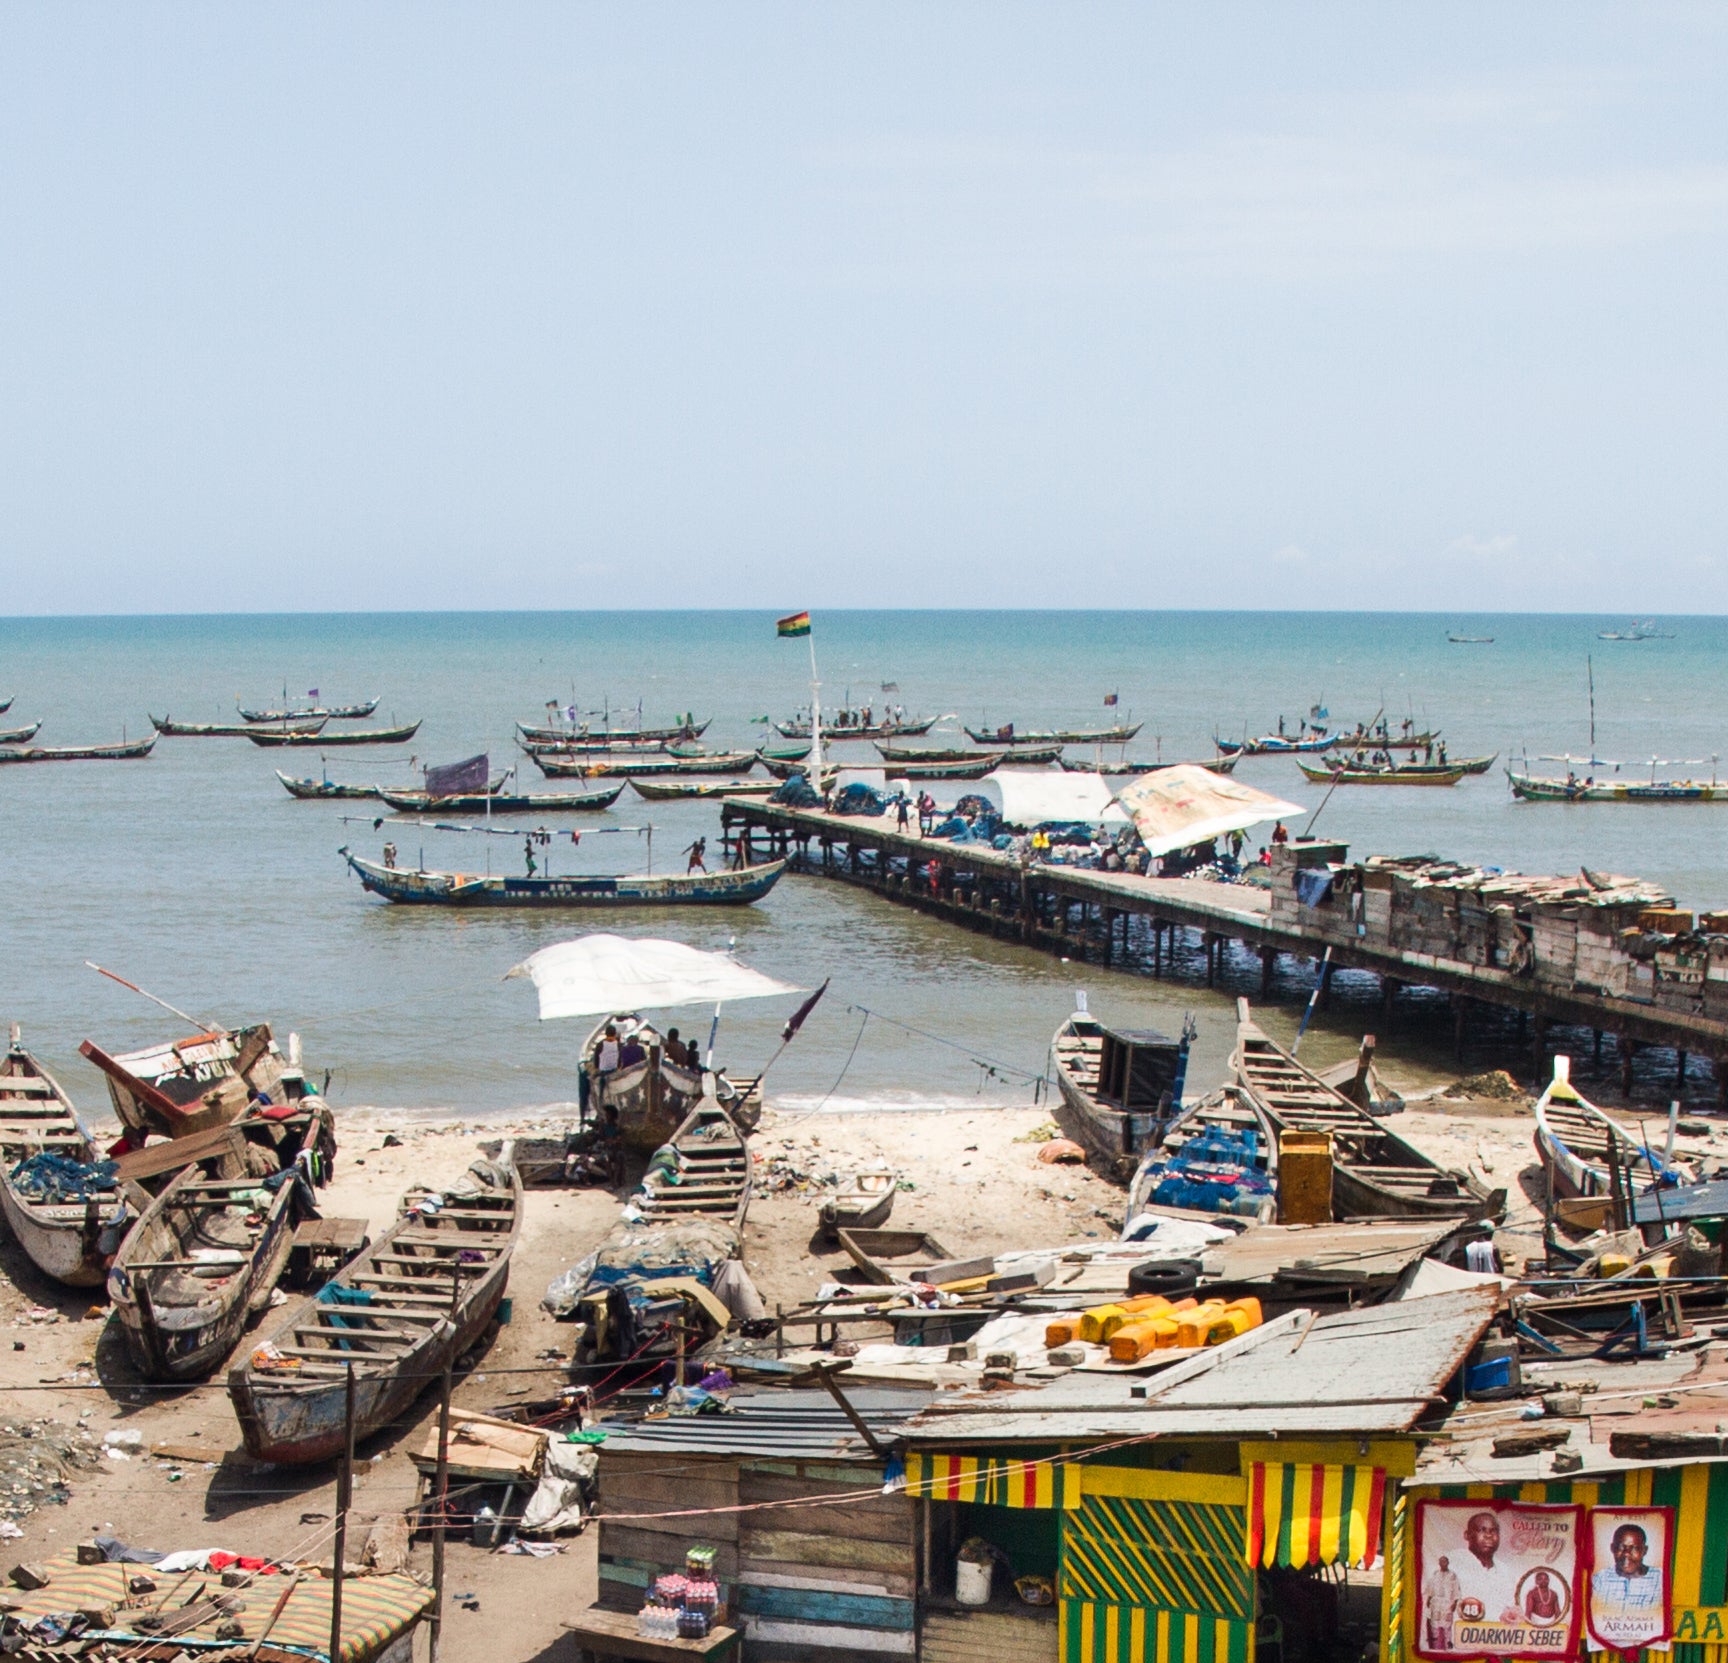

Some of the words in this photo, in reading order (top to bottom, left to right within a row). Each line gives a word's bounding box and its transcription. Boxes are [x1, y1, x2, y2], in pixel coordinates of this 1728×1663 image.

[1512, 1520, 1551, 1532] CALLED
[1554, 1523, 1570, 1533] TO
[1462, 1604, 1480, 1617] 48
[1603, 1620, 1654, 1632] ARMAH
[1460, 1627, 1526, 1645] ODARKWEI
[1527, 1630, 1565, 1647] SEBEE
